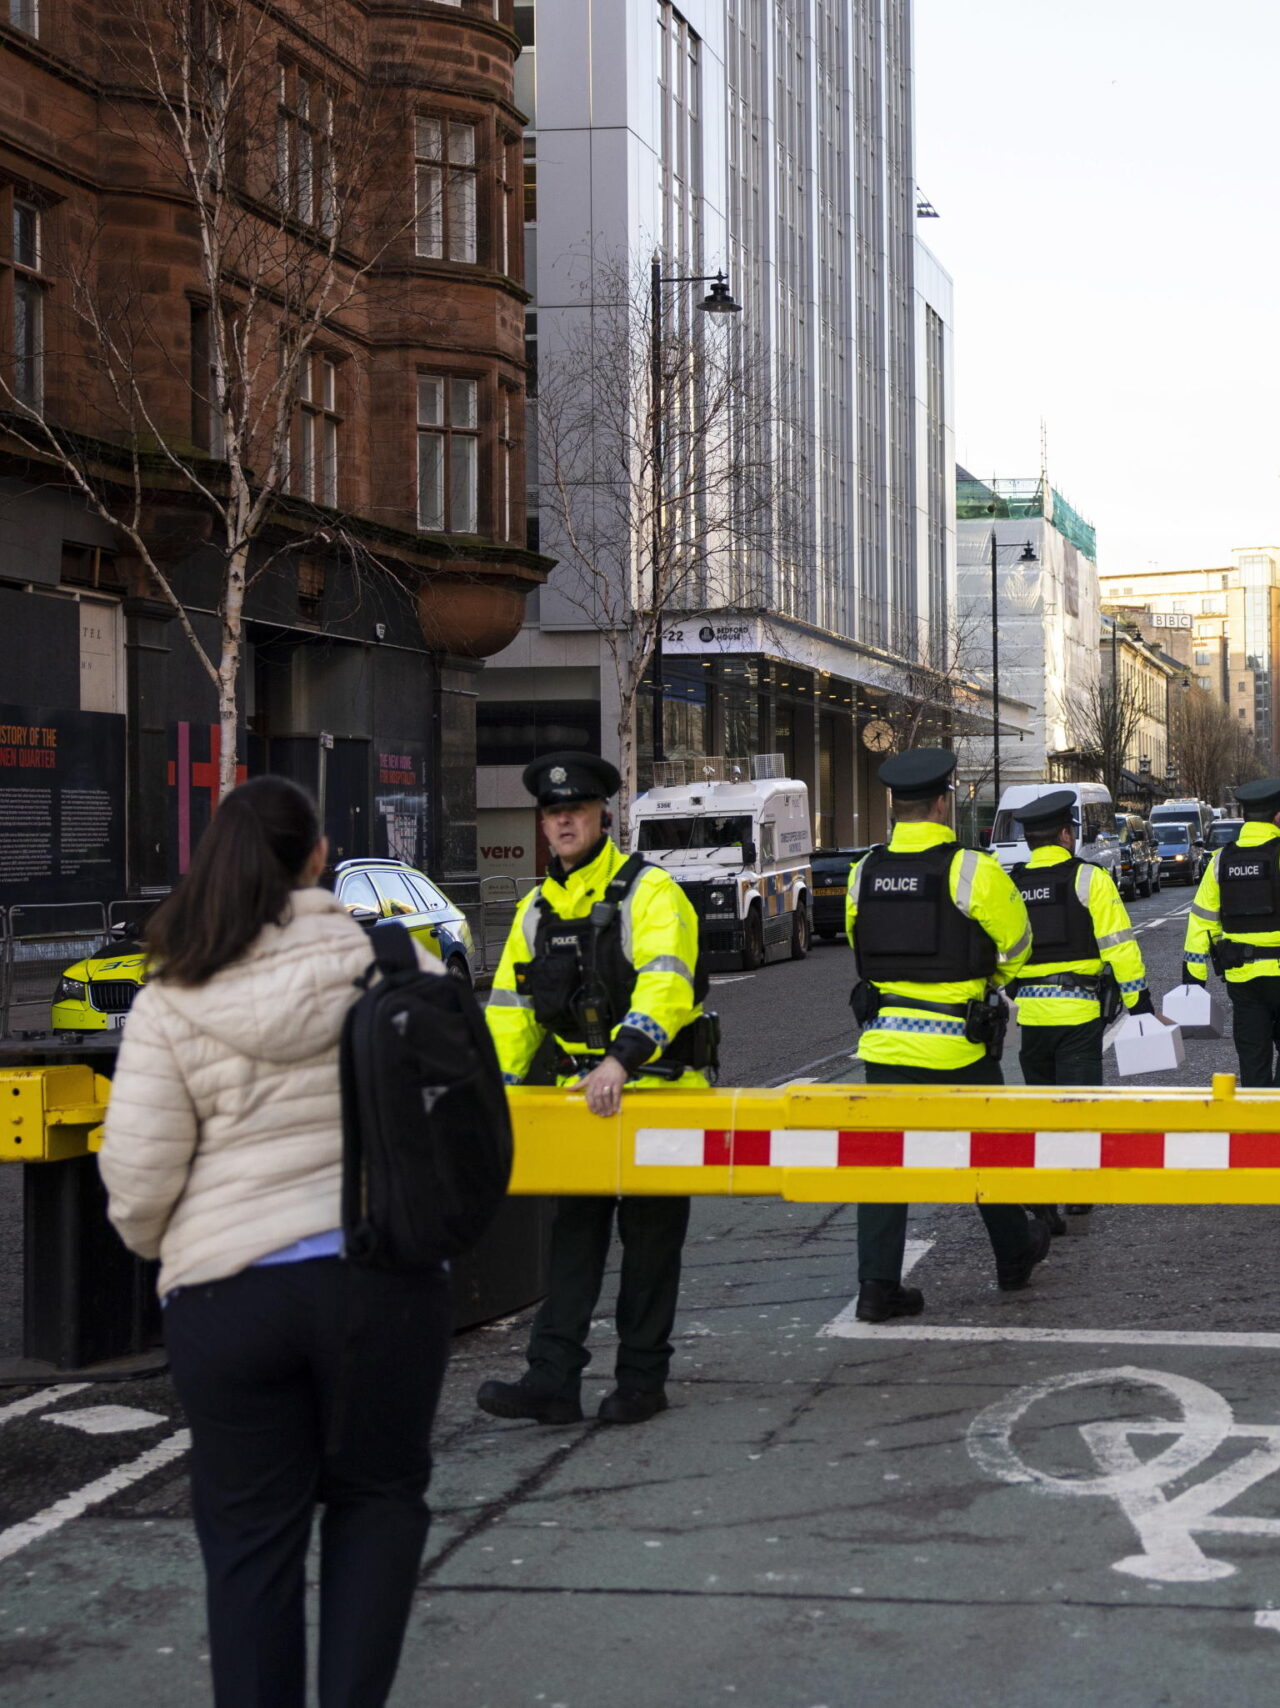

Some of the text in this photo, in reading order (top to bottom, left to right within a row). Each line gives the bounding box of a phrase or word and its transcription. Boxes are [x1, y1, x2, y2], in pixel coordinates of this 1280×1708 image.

[1156, 615, 1188, 627] BBC
[82, 627, 102, 640] TEL
[662, 630, 684, 642] -22
[716, 626, 749, 634] BEDFORD
[29, 727, 40, 746] OF
[42, 728, 57, 747] THE
[480, 845, 525, 859] vero
[1228, 865, 1260, 877] POLICE
[874, 878, 919, 892] POLICE
[1020, 887, 1050, 901] OLICE
[552, 935, 579, 946] POLICE
